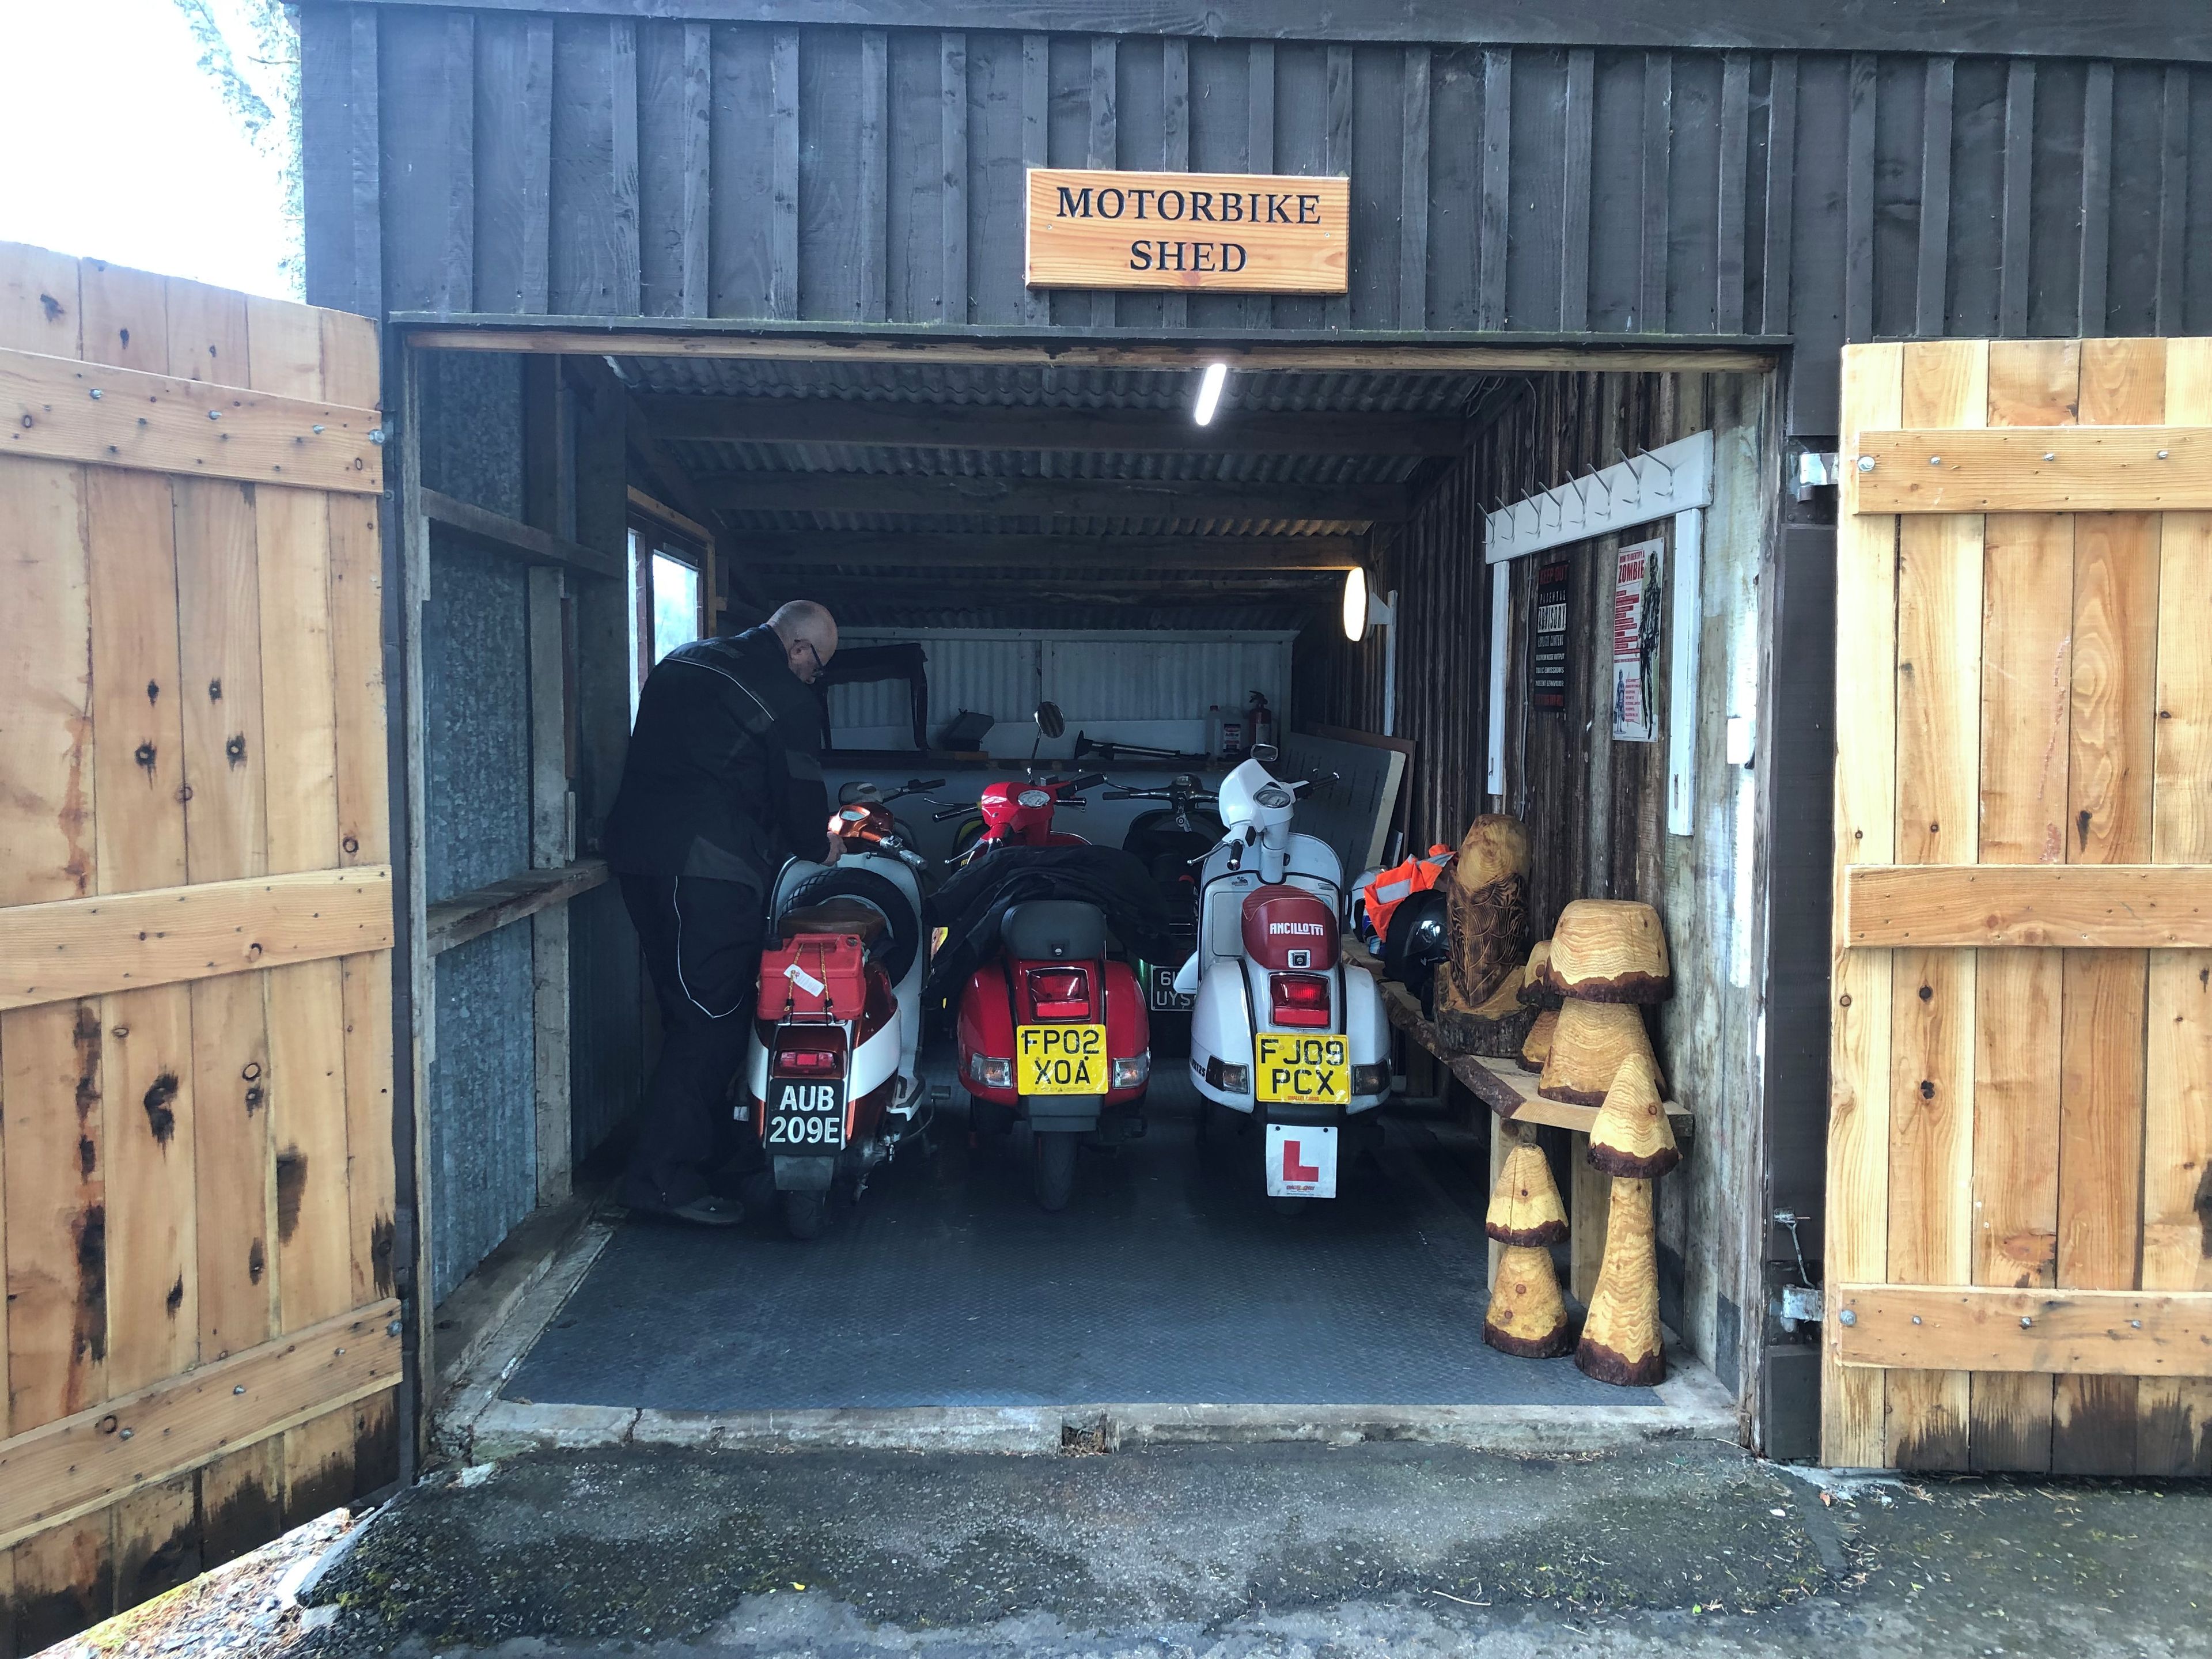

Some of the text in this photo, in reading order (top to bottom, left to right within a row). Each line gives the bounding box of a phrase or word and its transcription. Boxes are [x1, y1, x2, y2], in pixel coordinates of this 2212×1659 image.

[1056, 187, 1321, 225] MOTORBIKE
[1130, 240, 1248, 272] SHED
[1539, 565, 1569, 584] KEEP OUT
[1618, 559, 1645, 584] ZOMBIE
[1540, 590, 1566, 604] PARENTAL
[1270, 923, 1324, 937] ANCILLOTTI
[1157, 991, 1191, 1006] UYS
[1024, 1029, 1100, 1055] FP02
[1260, 1039, 1344, 1066] FJ09
[1034, 1060, 1090, 1085] XOA
[1272, 1069, 1335, 1096] PCX
[779, 1085, 834, 1112] AUB
[770, 1116, 840, 1143] 209E
[1283, 1140, 1319, 1182] L
